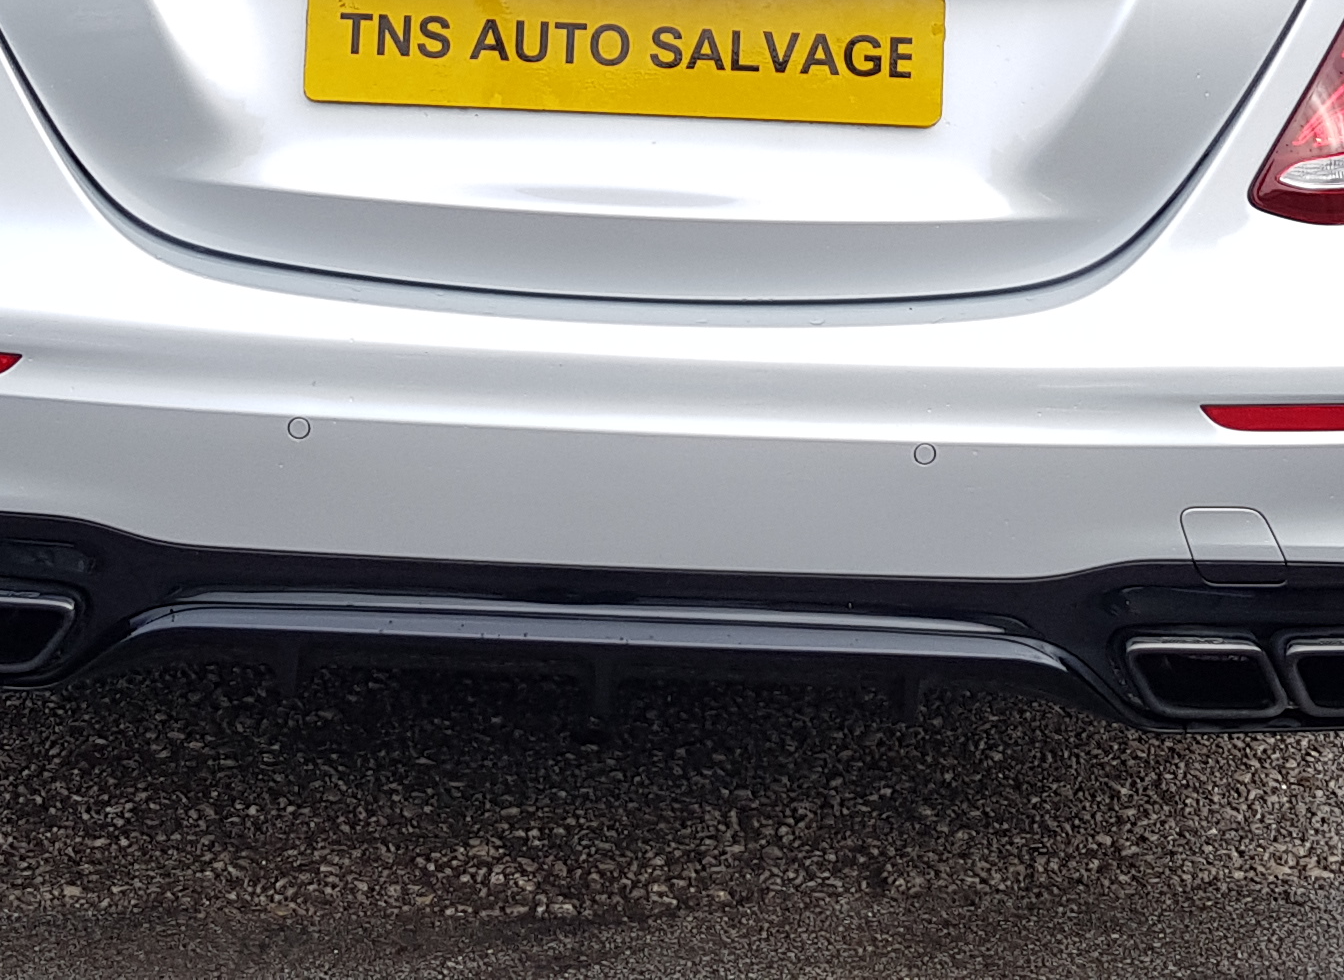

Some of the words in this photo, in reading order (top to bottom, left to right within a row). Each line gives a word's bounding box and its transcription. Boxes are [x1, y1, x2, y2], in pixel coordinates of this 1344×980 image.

[339, 11, 452, 59] TNS
[469, 18, 631, 67] AUTO
[649, 25, 914, 80] SALVAGE
